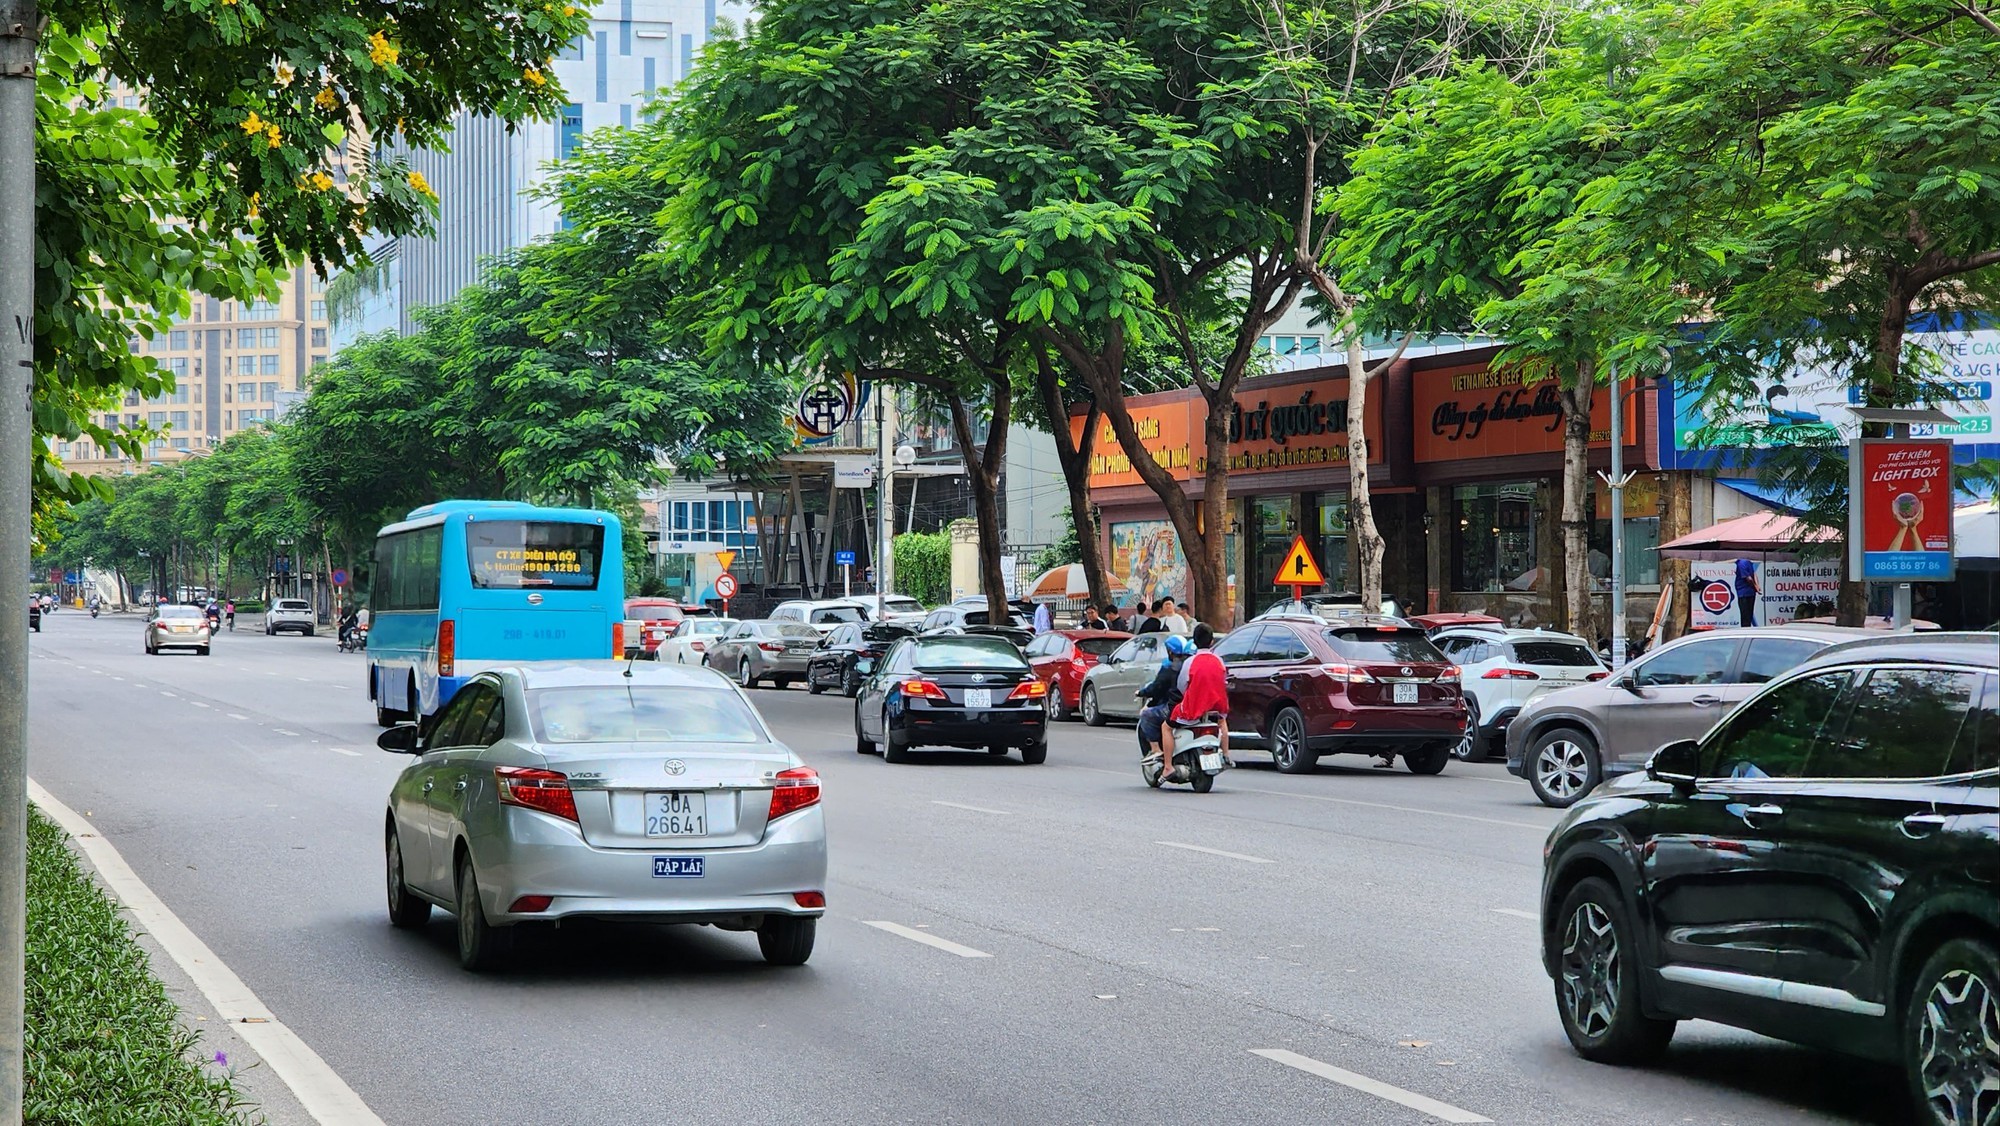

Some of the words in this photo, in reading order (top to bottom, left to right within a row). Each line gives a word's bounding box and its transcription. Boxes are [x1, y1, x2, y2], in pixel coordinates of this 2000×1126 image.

[1968, 363, 1991, 376] VG
[1452, 371, 1499, 392] VIETNAMESE
[1501, 368, 1521, 385] BEEF
[1244, 401, 1270, 440] LÝ
[1271, 390, 1326, 444] QUỐC
[1138, 417, 1160, 440] SÁNG
[1107, 450, 1132, 473] PHÒNG
[1887, 449, 1907, 461] TIẾT
[1907, 449, 1932, 461] KIỆM
[1872, 469, 1911, 482] LIGHT
[1911, 467, 1941, 479] BOX
[496, 551, 508, 559] CT
[1767, 566, 1780, 577] CỬA
[1782, 567, 1801, 577] HÀNG
[1802, 567, 1815, 578] VẬT
[1817, 567, 1832, 578] LIỆU
[1874, 561, 1898, 570] 0865
[1900, 561, 1912, 570] 86
[1914, 561, 1926, 570] 87
[1928, 561, 1941, 570] 86
[1776, 582, 1813, 591] QUANG
[1779, 604, 1795, 613] CÁT
[660, 795, 691, 813] 30A
[648, 816, 703, 834] 266.41
[656, 858, 679, 875] TẬP
[681, 859, 701, 873] LÁI
